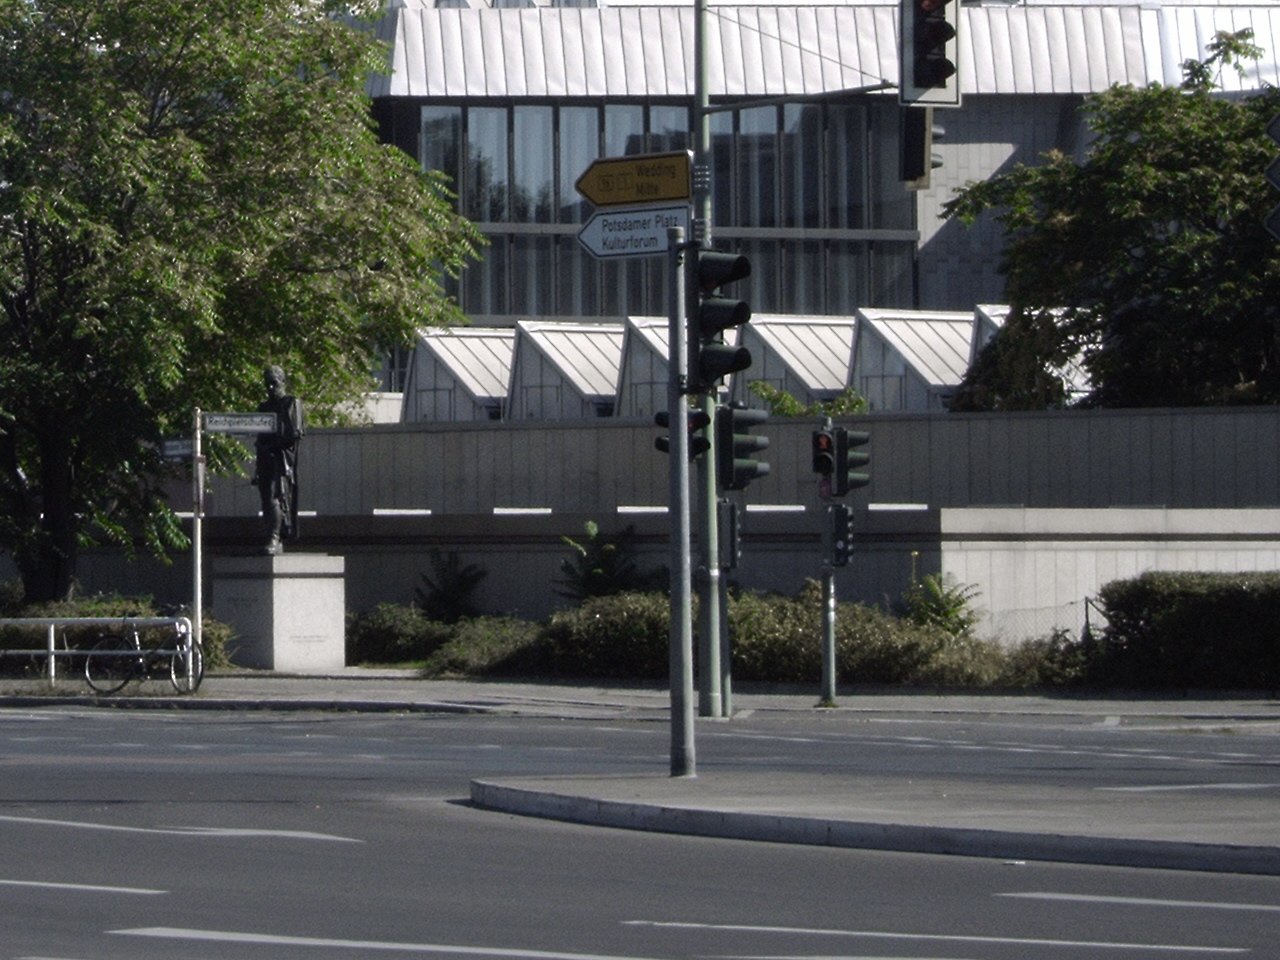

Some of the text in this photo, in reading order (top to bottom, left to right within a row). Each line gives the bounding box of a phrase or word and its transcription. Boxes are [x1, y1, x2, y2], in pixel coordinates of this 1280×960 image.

[602, 214, 678, 232] Potsdamer Platz
[602, 236, 659, 251] Kulturforum
